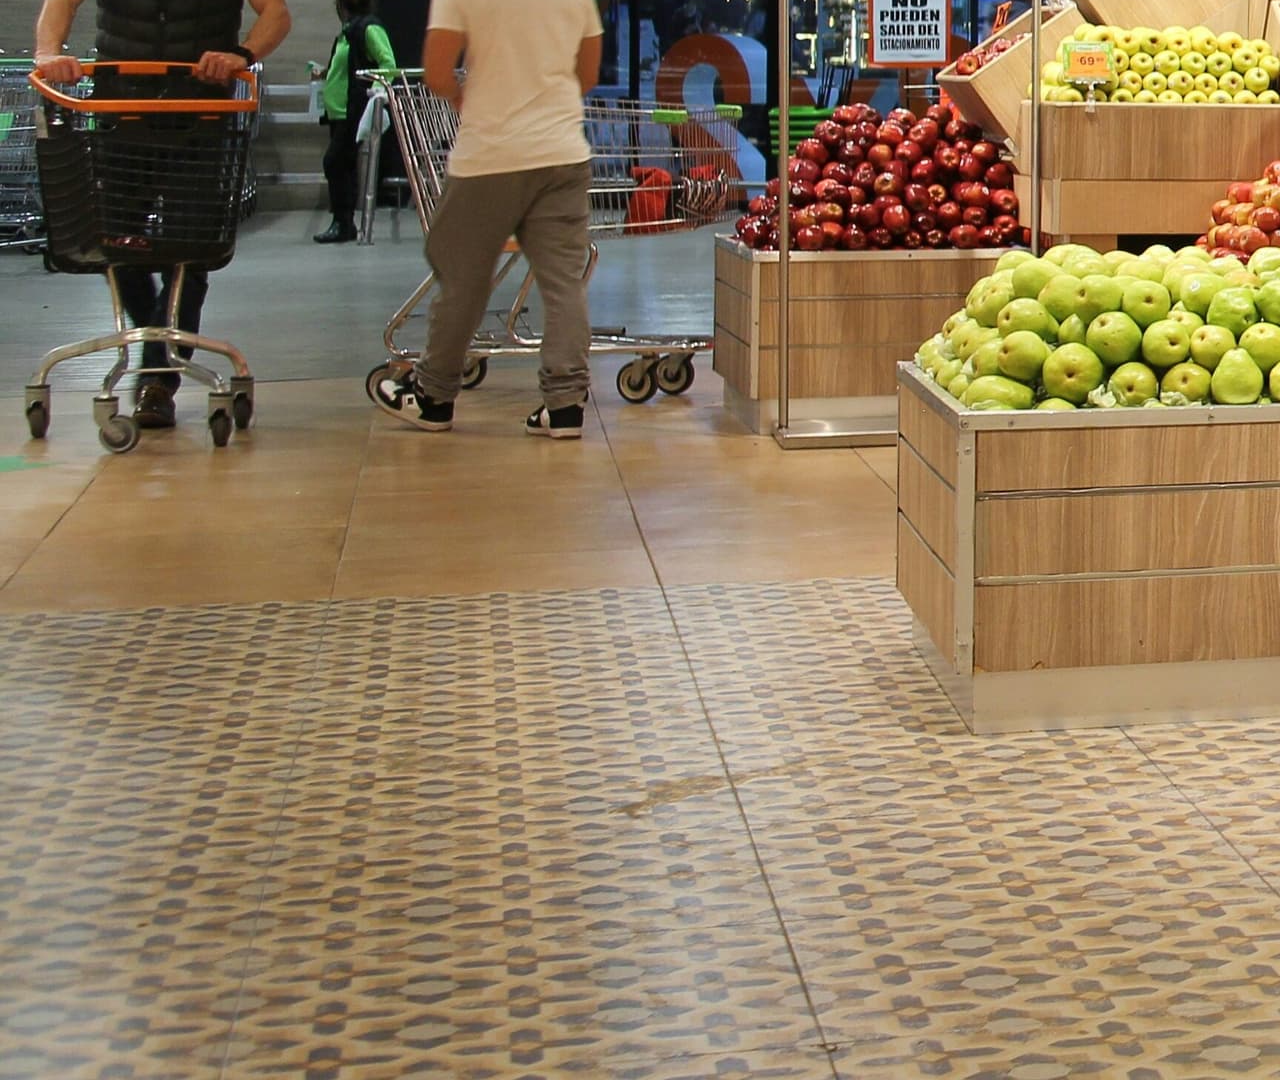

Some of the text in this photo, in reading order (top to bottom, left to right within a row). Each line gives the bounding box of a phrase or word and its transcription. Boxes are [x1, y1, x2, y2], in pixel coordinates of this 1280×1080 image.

[880, 9, 940, 22] PUEDEN
[880, 24, 940, 37] SALIR DEL
[880, 38, 941, 51] ESTACIONAMIENTO
